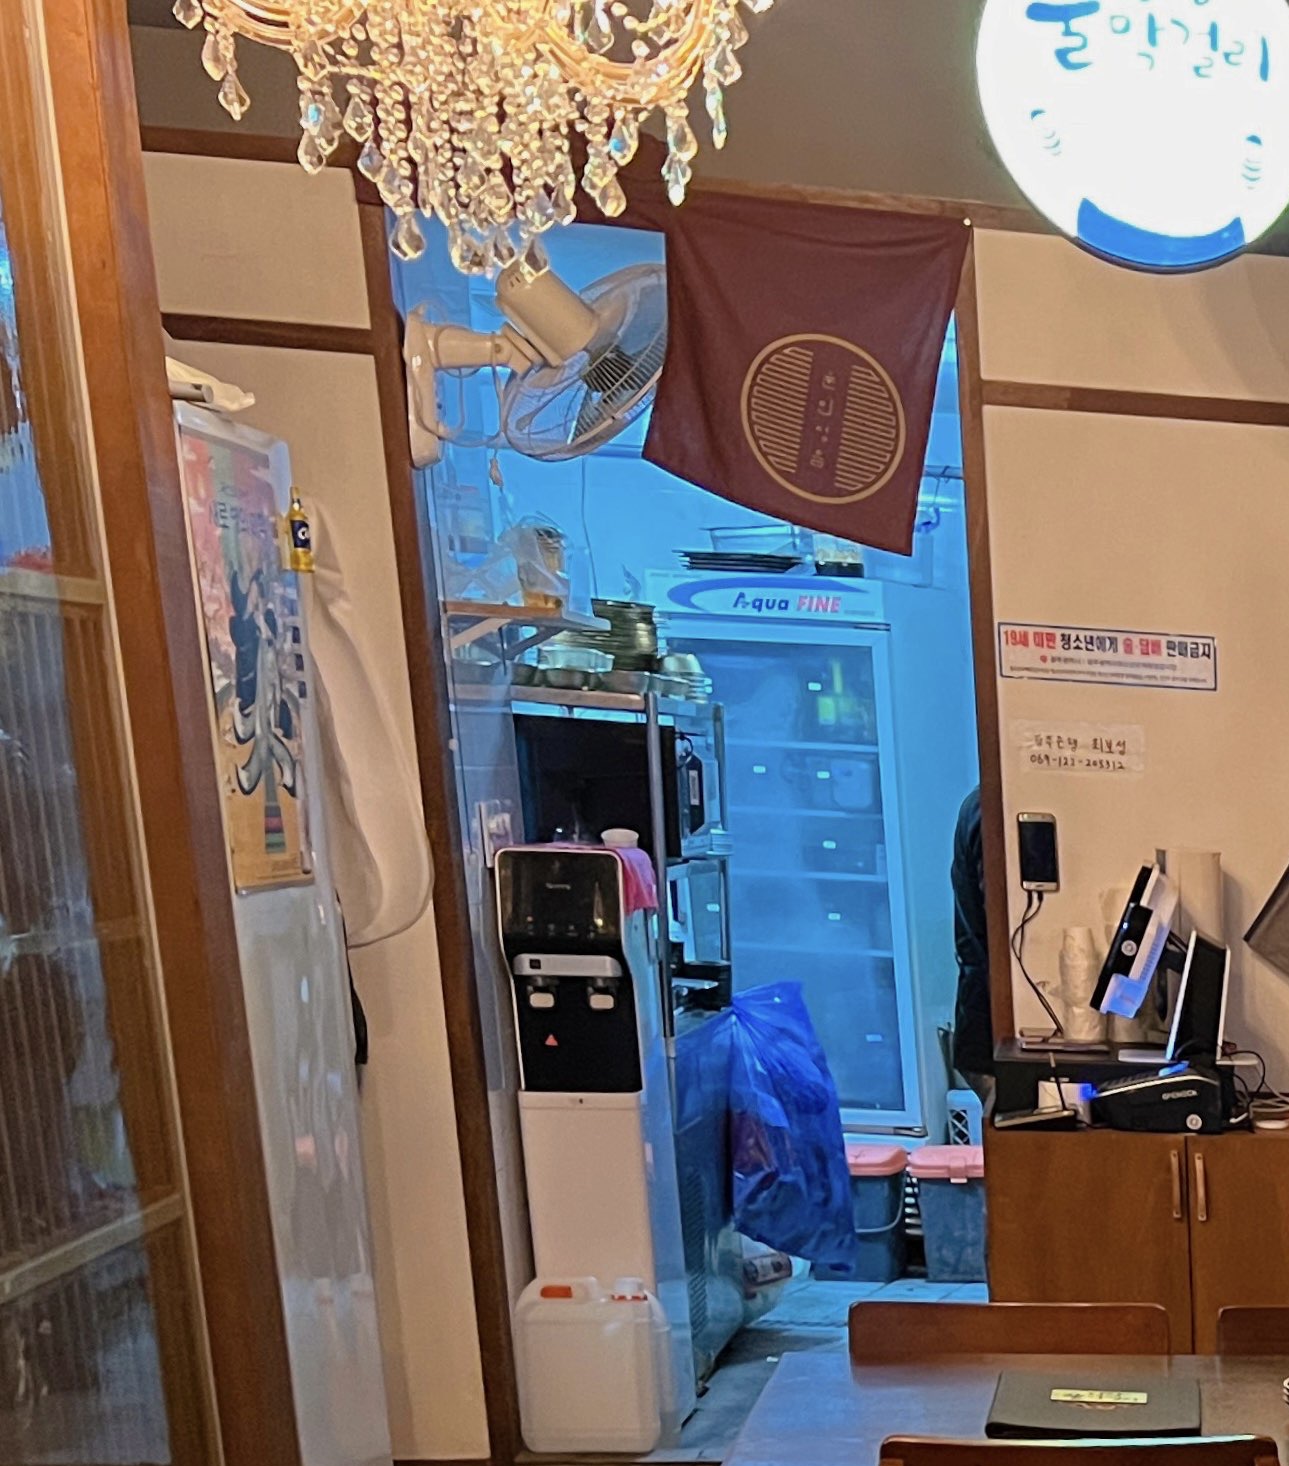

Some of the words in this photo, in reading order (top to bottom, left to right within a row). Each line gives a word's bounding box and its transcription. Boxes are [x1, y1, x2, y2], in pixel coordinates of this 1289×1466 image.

[733, 592, 790, 613] Aqua
[796, 595, 842, 614] FINE
[1003, 630, 1030, 648] 19세
[1033, 631, 1056, 649] 미만
[1060, 633, 1118, 653] 청소년에게
[1166, 640, 1211, 659] 판매금지
